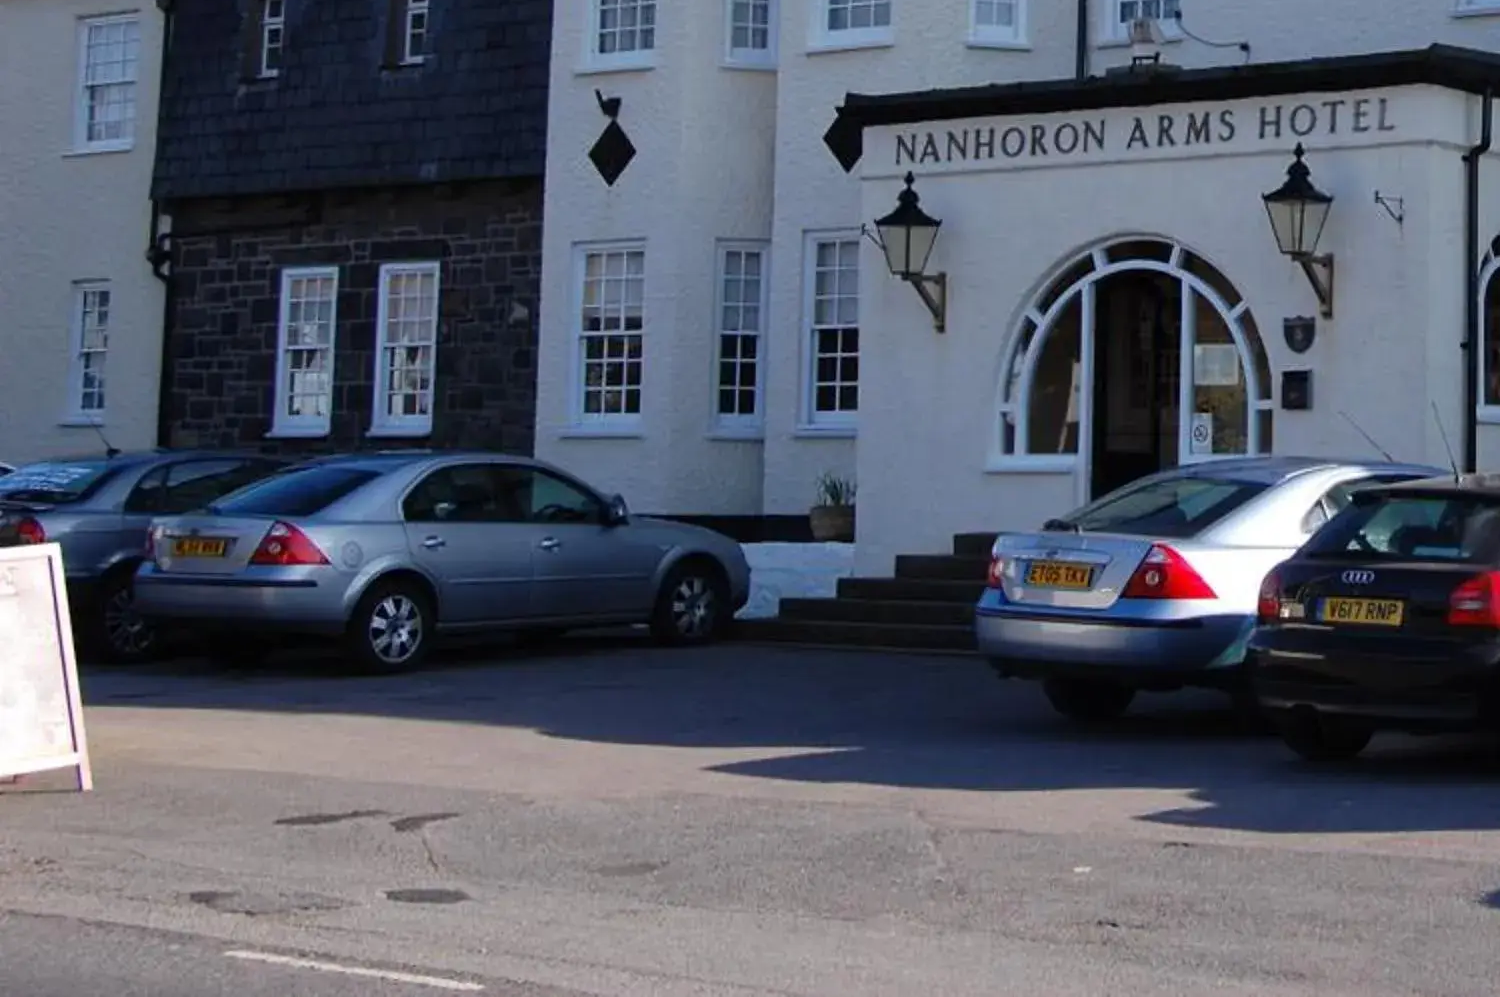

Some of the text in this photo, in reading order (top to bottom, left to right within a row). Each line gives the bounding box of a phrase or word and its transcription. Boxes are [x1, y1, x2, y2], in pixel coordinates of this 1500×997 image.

[895, 97, 1397, 165] NANHORON ARMS HOTEL
[1329, 599, 1398, 621] V617 RNP
